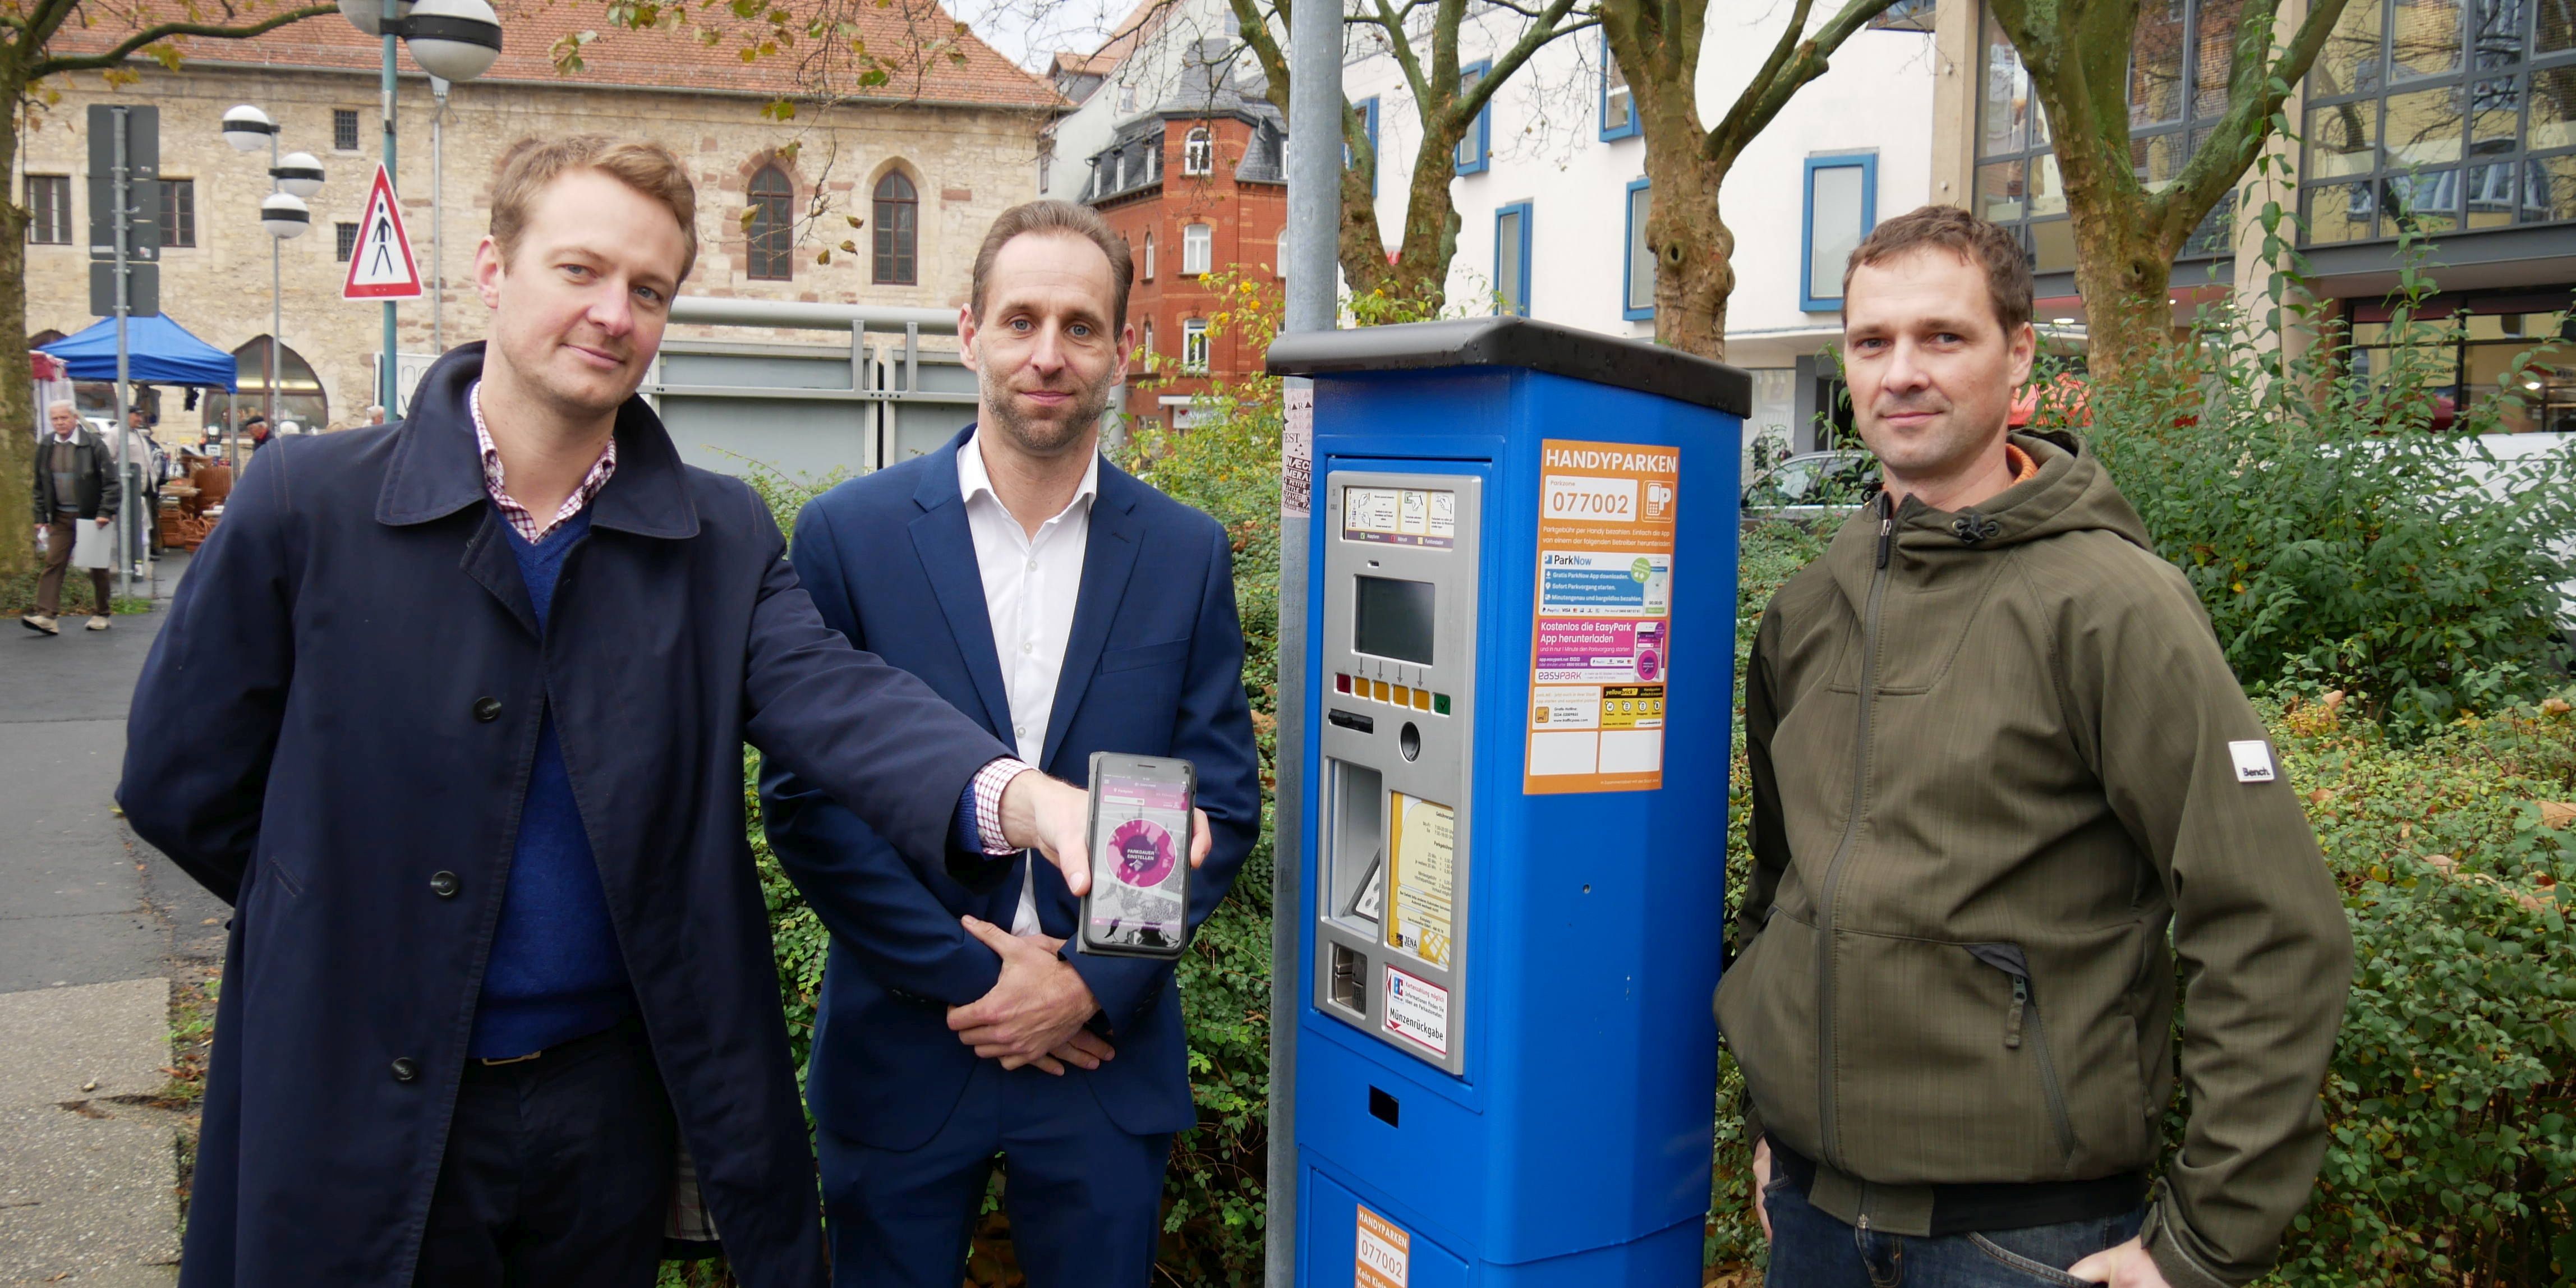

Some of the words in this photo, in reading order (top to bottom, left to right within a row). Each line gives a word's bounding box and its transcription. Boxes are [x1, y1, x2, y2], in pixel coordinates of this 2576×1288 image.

[1546, 448, 1676, 473] HANDYPARKEN
[1553, 491, 1628, 514] 077002
[1543, 526, 1575, 535] Parkgebühr
[1586, 527, 1605, 536] Handy
[1584, 538, 1611, 546] folgenden
[1554, 554, 1592, 566] ParkNow
[1540, 622, 1579, 631] Kostenlos
[1581, 622, 1594, 632] die
[1595, 622, 1631, 634] EasyPark
[1540, 633, 1557, 646] App
[1558, 633, 1614, 643] herunterladen
[1404, 936, 1418, 949] JENA
[1405, 990, 1428, 1005] Informationen
[1428, 1000, 1438, 1010] finden
[1406, 981, 1430, 998] Kartenzahlung
[1430, 993, 1445, 1003] möglich
[1418, 1003, 1443, 1019] Parkautomaten.
[1390, 1007, 1443, 1041] Münzenrückgabe
[1359, 1209, 1407, 1249] HANDYPARKEN
[1361, 1239, 1402, 1279] 077002
[1358, 1266, 1371, 1284] Kein
